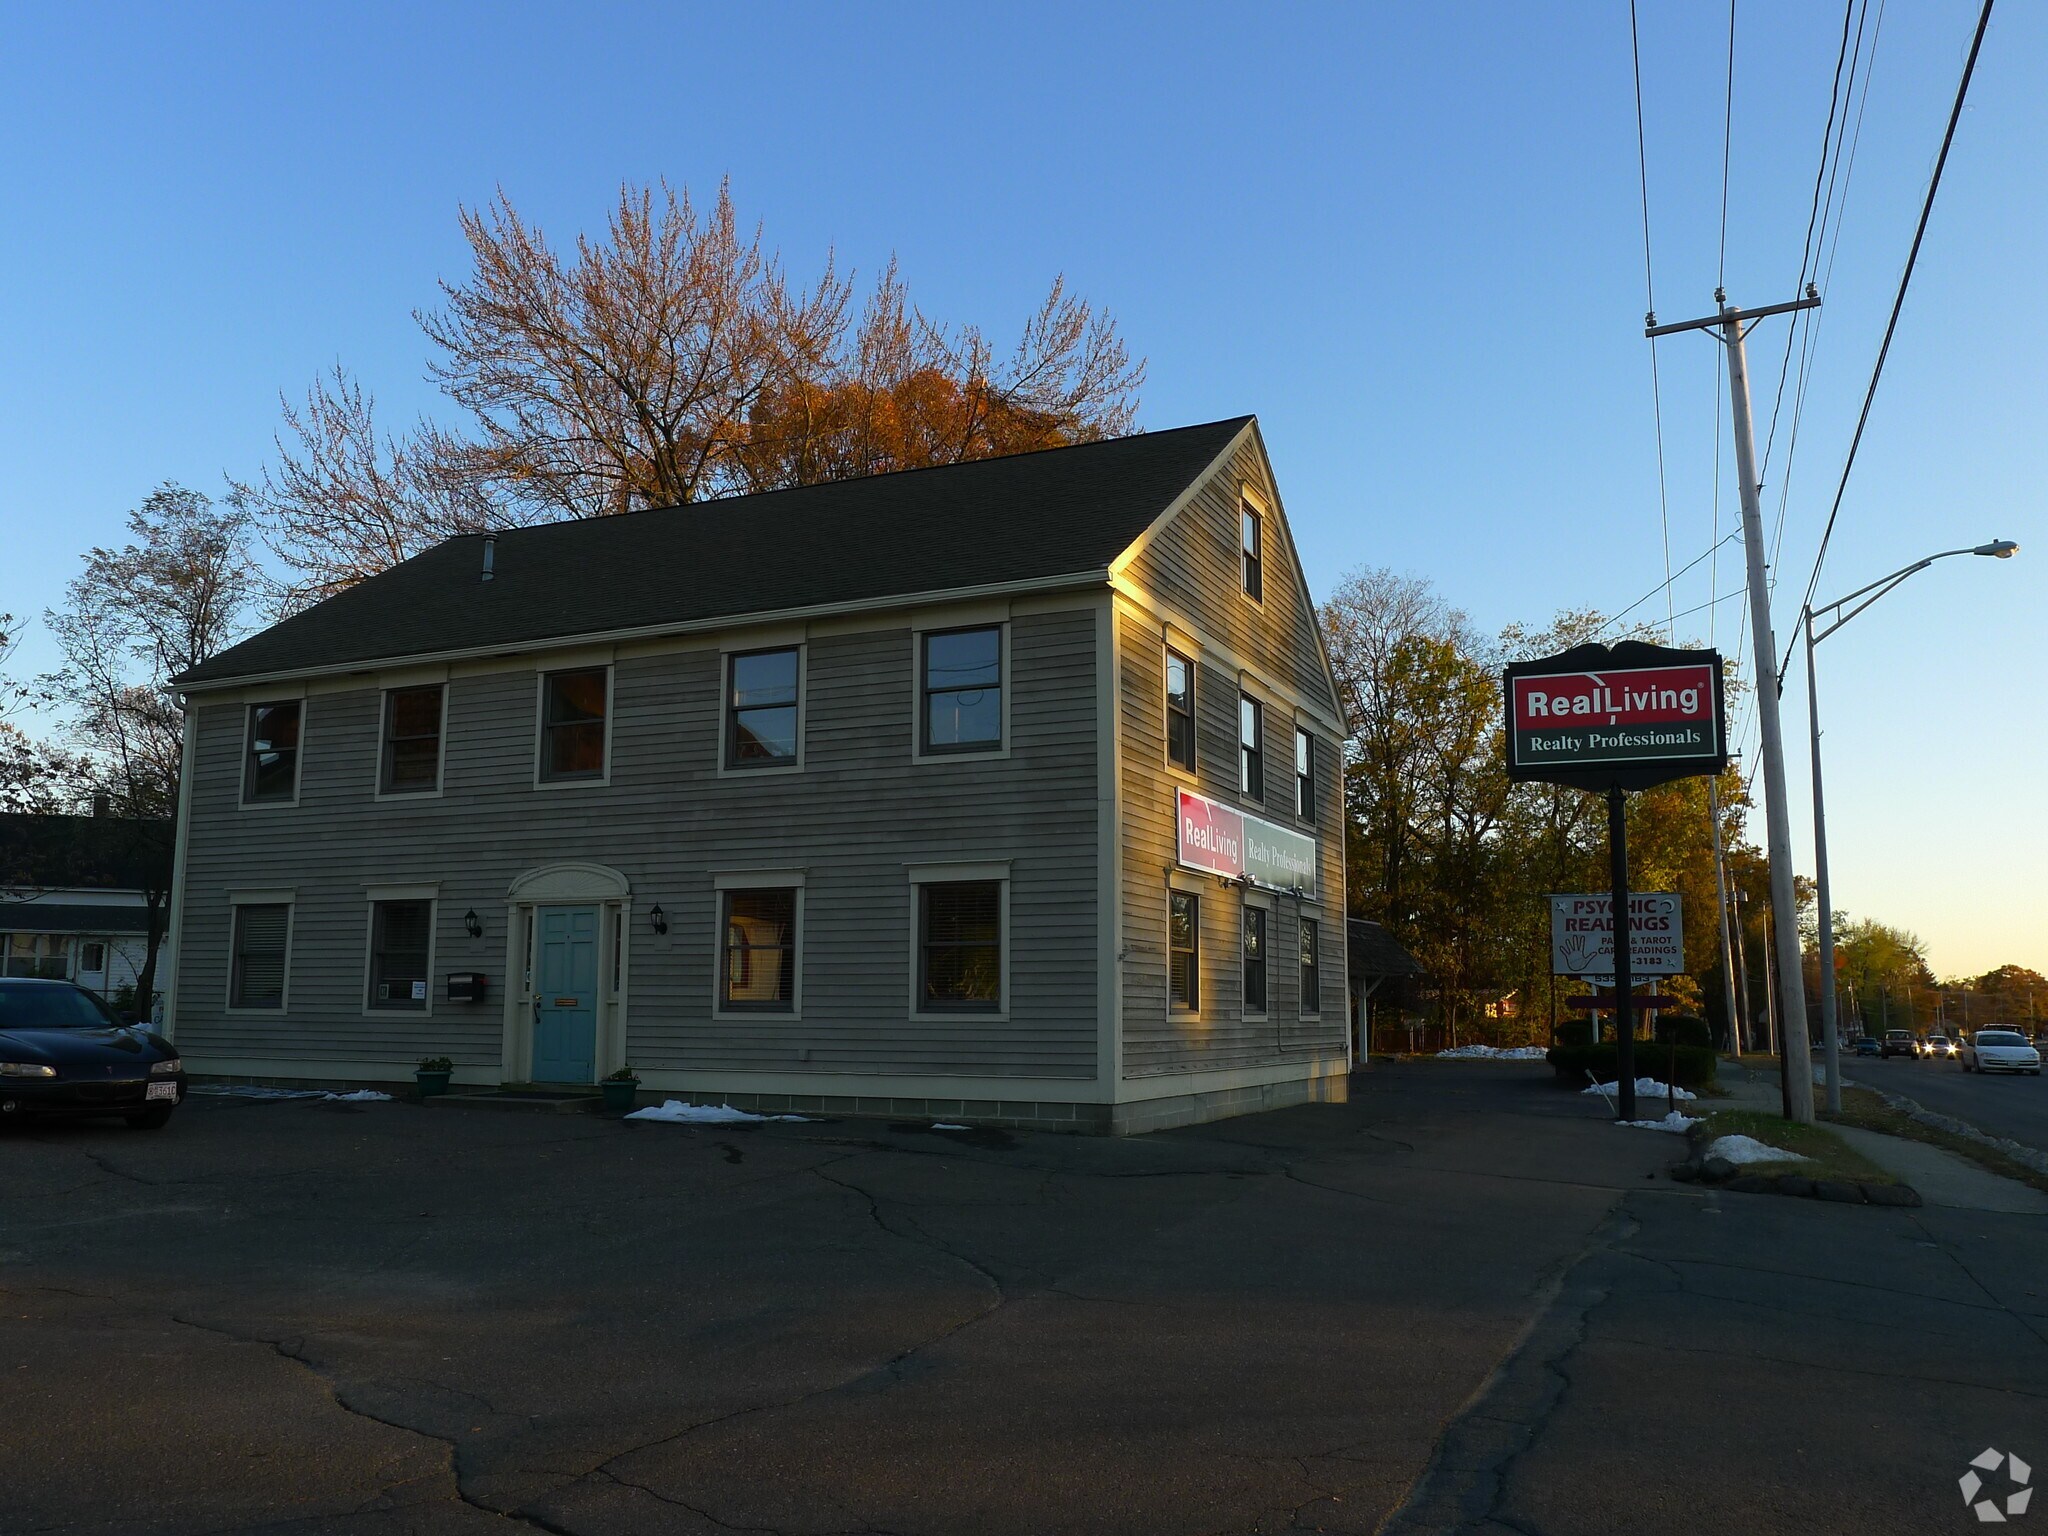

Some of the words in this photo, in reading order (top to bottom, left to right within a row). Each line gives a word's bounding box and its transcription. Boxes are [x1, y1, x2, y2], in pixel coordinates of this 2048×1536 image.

[1530, 735, 1583, 752] Realty
[1588, 729, 1701, 748] Professionals
[1248, 838, 1270, 867] Realty
[1272, 846, 1312, 876] Professionals
[1565, 917, 1669, 931] READNGS
[1640, 937, 1672, 945] TAROT
[1628, 946, 1677, 954] EADINGS
